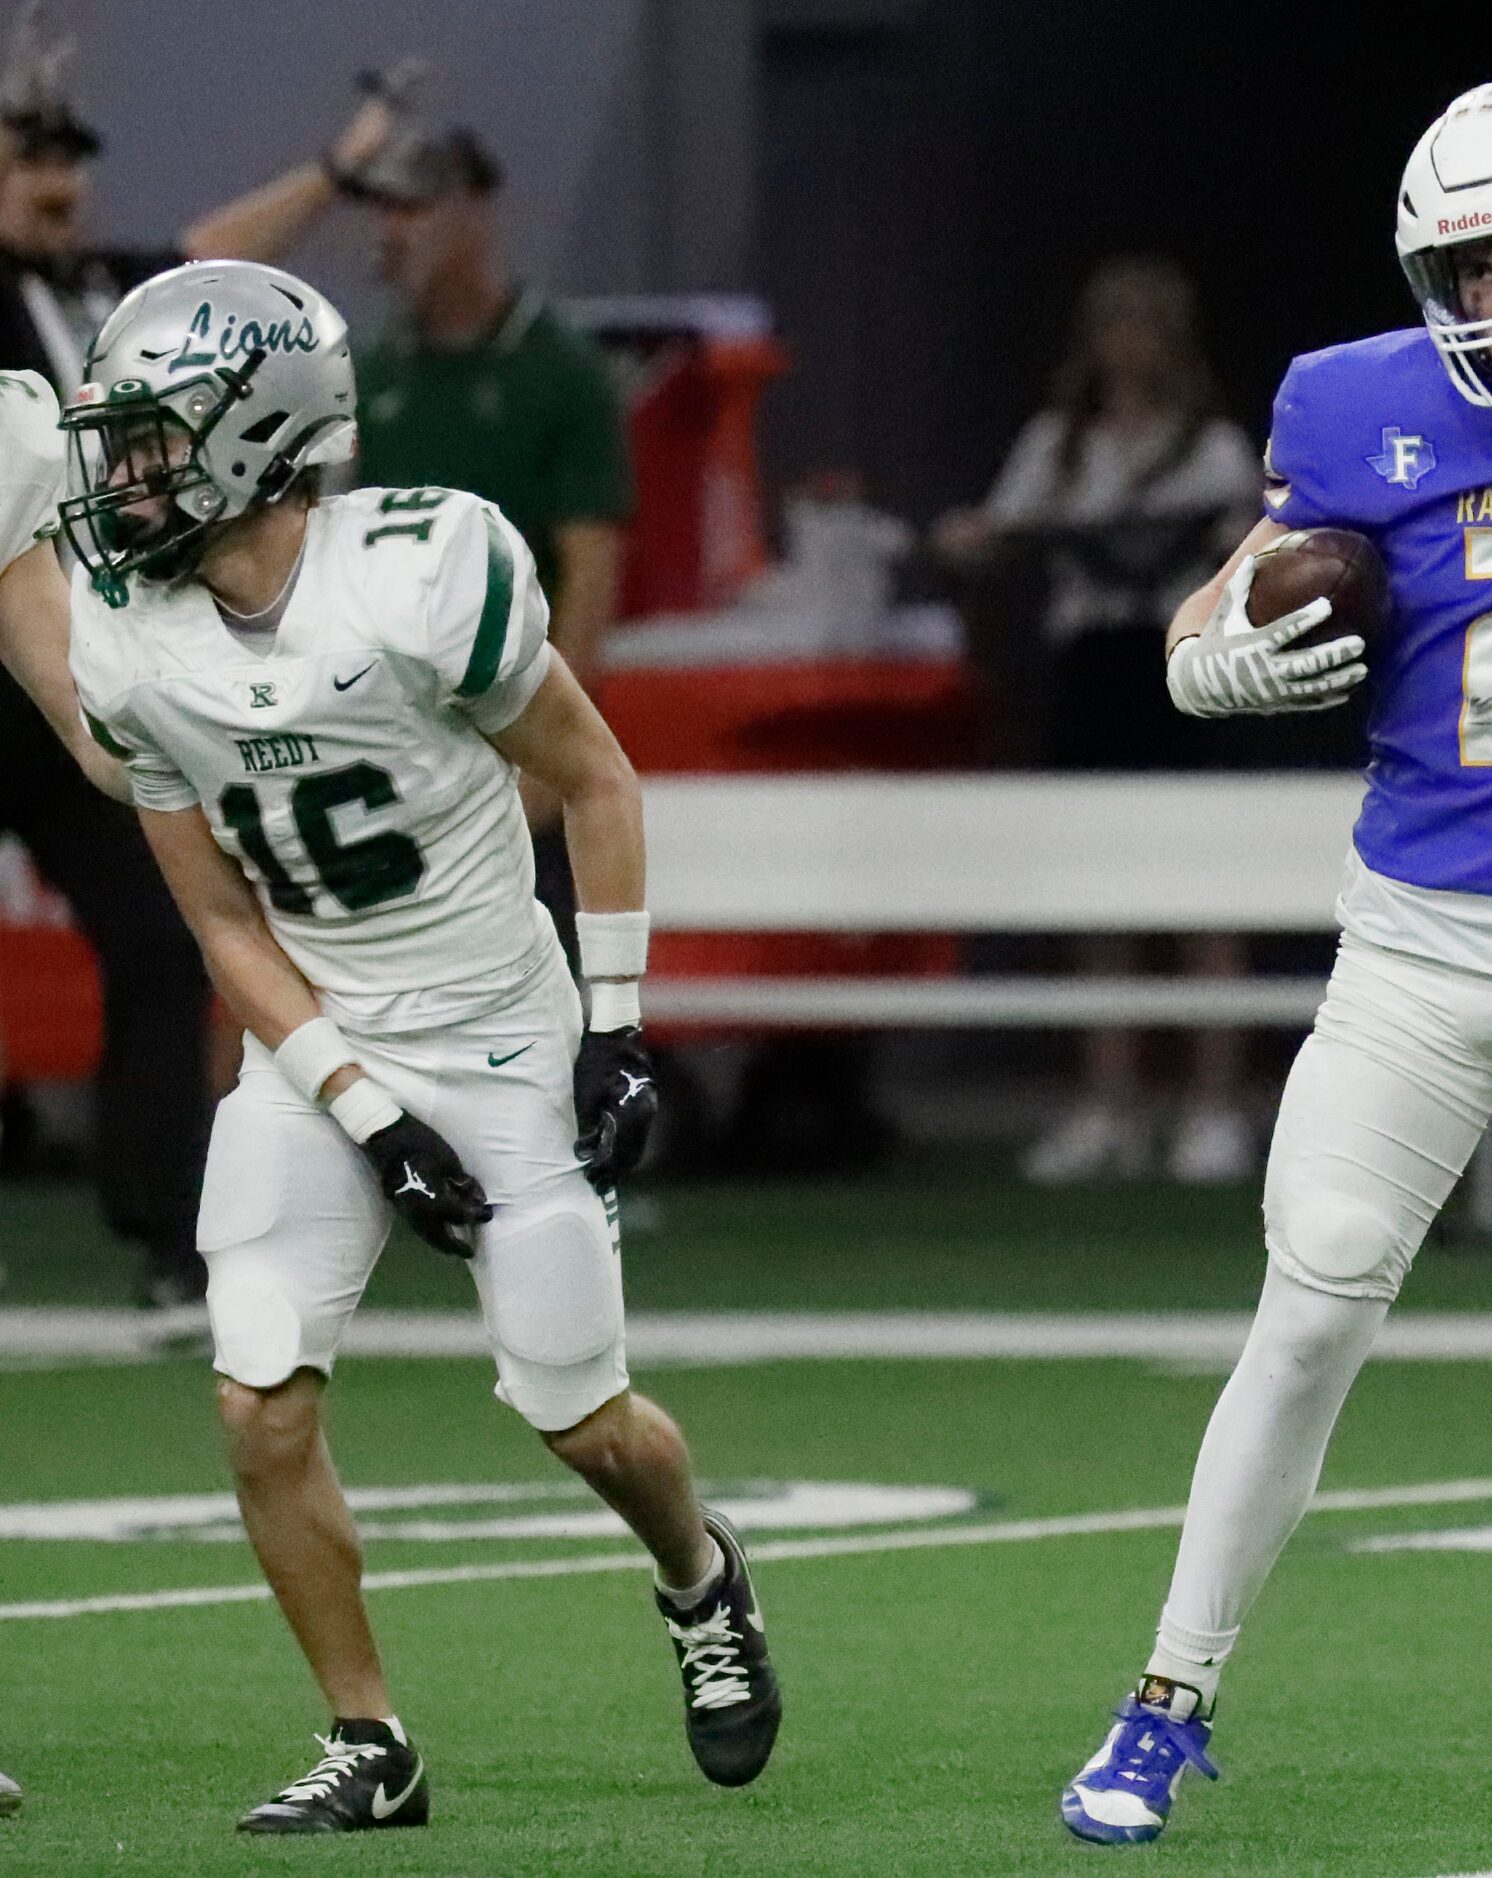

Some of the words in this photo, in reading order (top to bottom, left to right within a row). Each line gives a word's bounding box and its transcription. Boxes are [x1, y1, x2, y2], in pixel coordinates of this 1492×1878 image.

[169, 301, 319, 374] Lions
[1387, 436, 1422, 484] F
[250, 682, 278, 708] R
[234, 734, 319, 772] REEDY
[217, 758, 428, 914] 16
